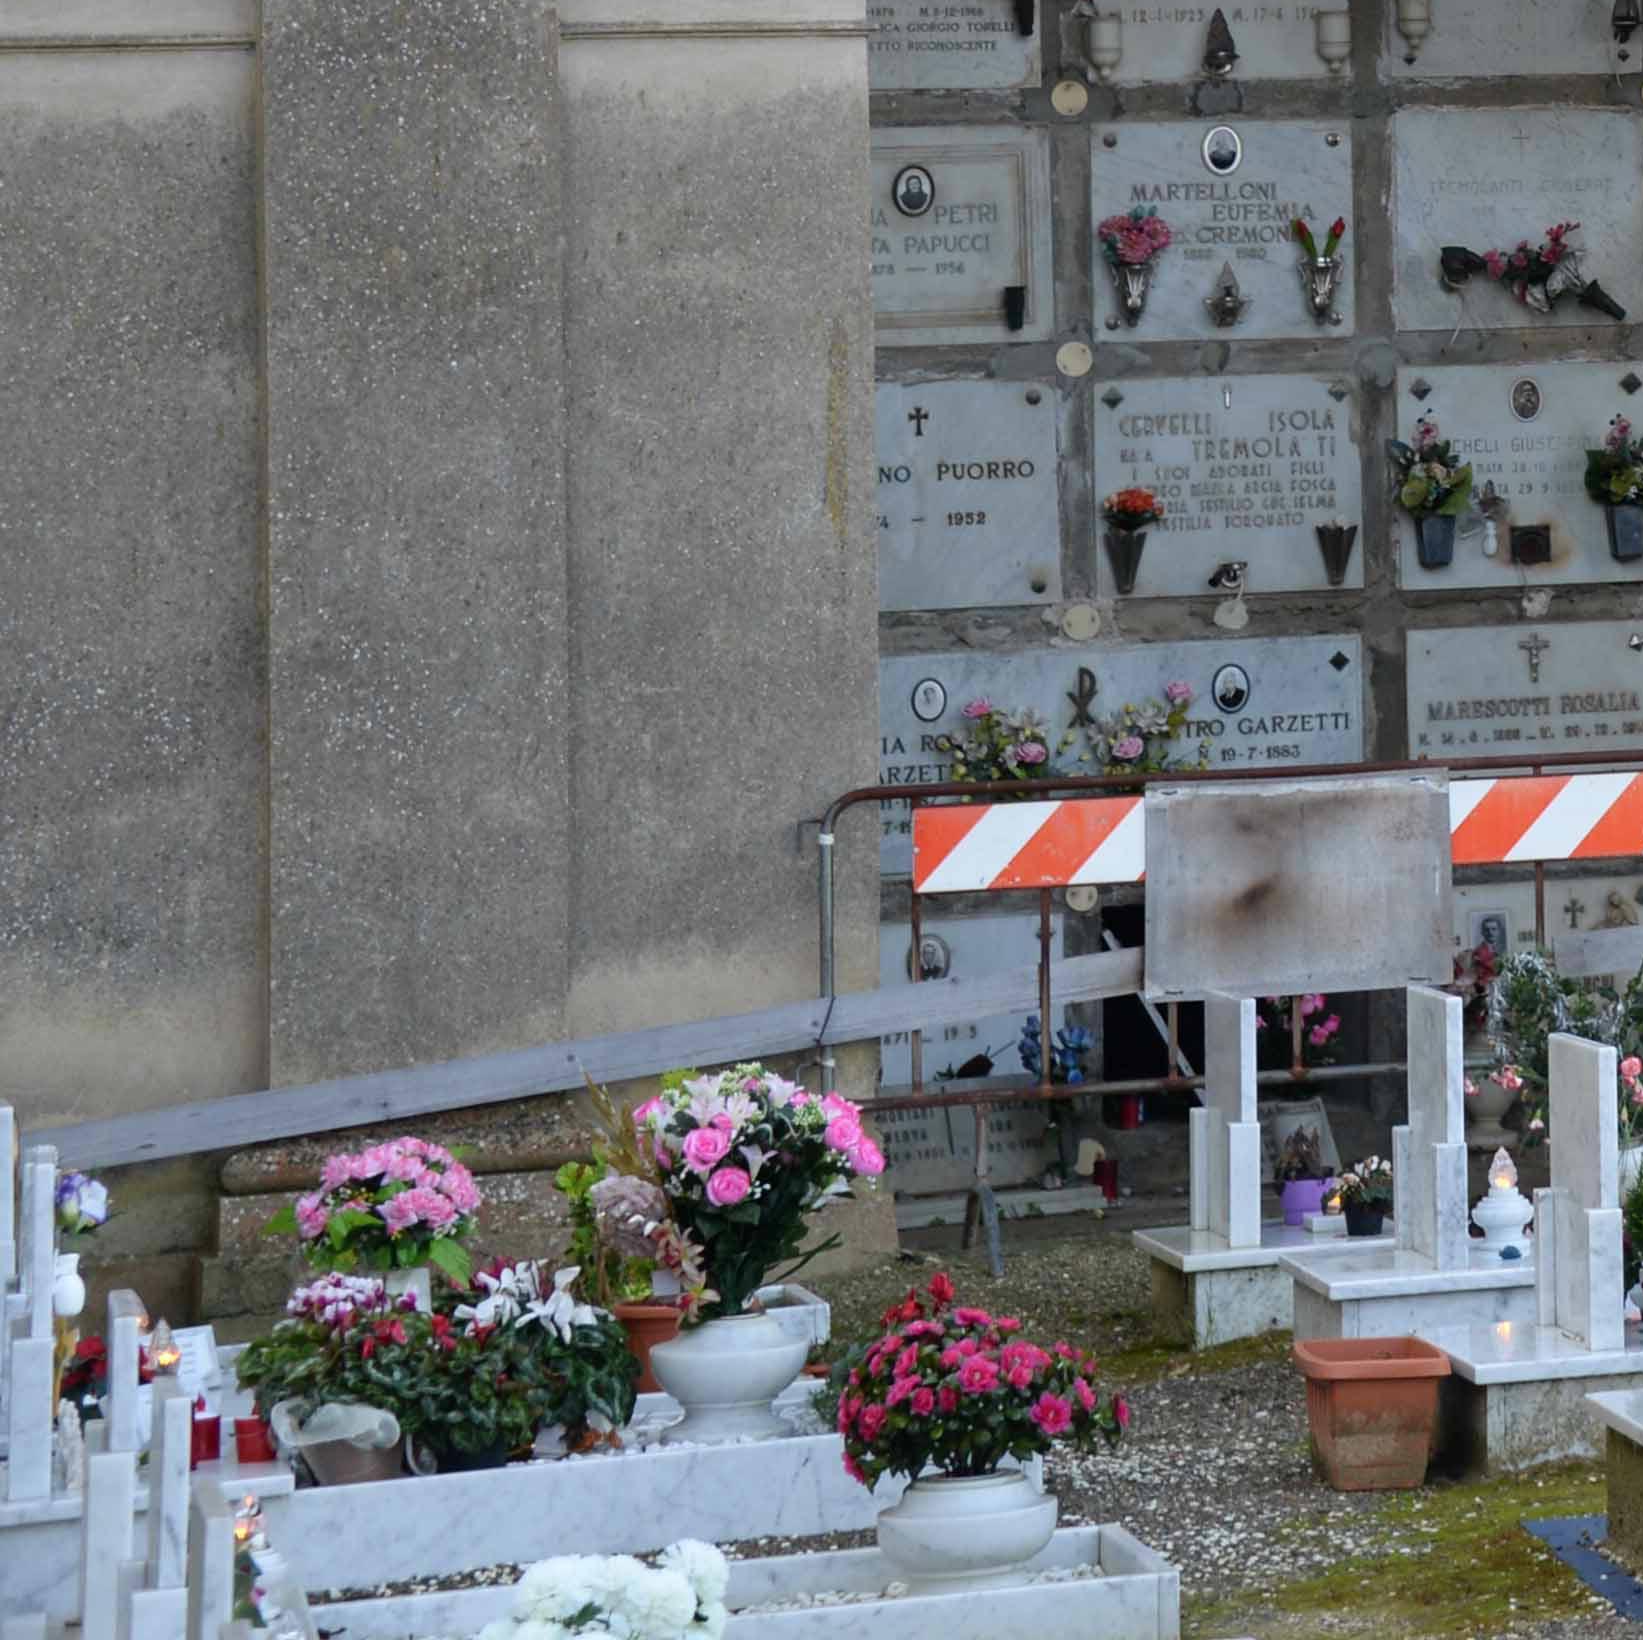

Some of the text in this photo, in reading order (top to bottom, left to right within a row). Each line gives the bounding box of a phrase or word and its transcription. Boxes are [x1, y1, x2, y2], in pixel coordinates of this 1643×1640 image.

[1130, 181, 1278, 203] MARTELLONI
[934, 204, 998, 225] PETRI
[903, 234, 990, 254] PAPUCCI
[1268, 409, 1335, 432] ISOLA
[936, 460, 1035, 481] PUORRO
[1237, 711, 1351, 736] GARZETTI
